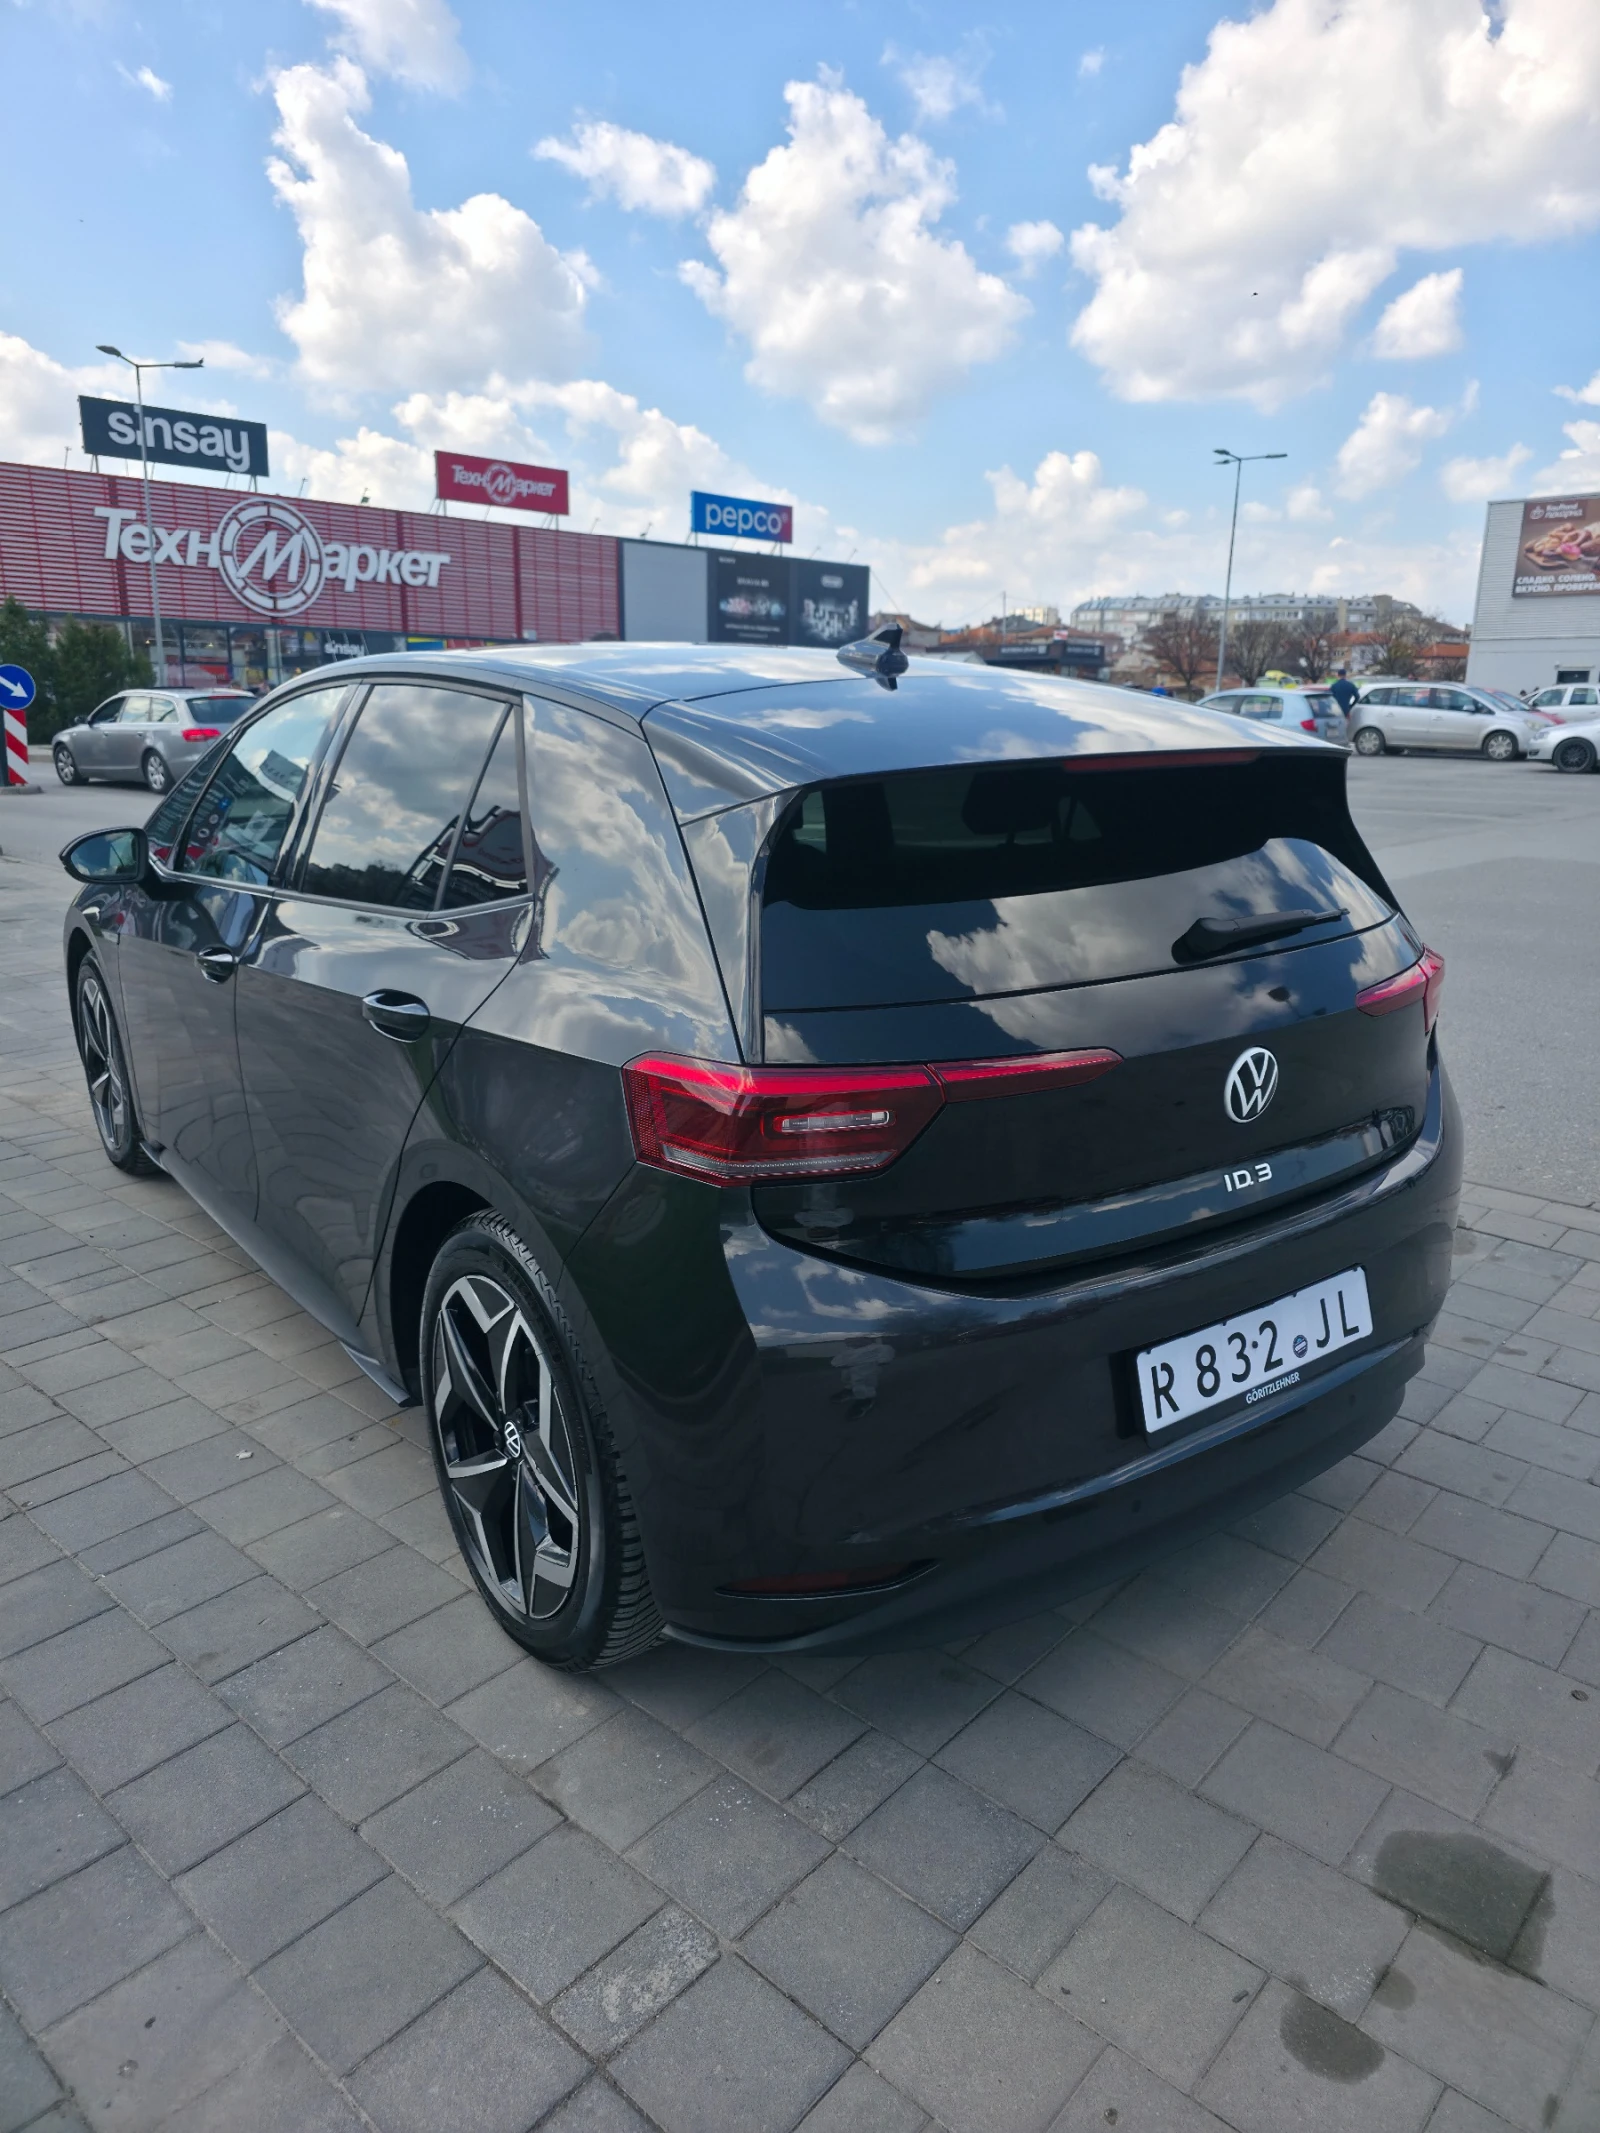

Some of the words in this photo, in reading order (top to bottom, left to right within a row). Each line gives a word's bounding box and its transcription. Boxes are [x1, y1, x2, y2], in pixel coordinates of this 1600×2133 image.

[107, 403, 250, 473] sinsay
[705, 503, 782, 534] pepco
[1151, 1362, 1180, 1419] R
[1195, 1320, 1284, 1397] 832
[1316, 1290, 1360, 1348] JL
[1245, 1371, 1300, 1404] GÖRITZLEHNER
